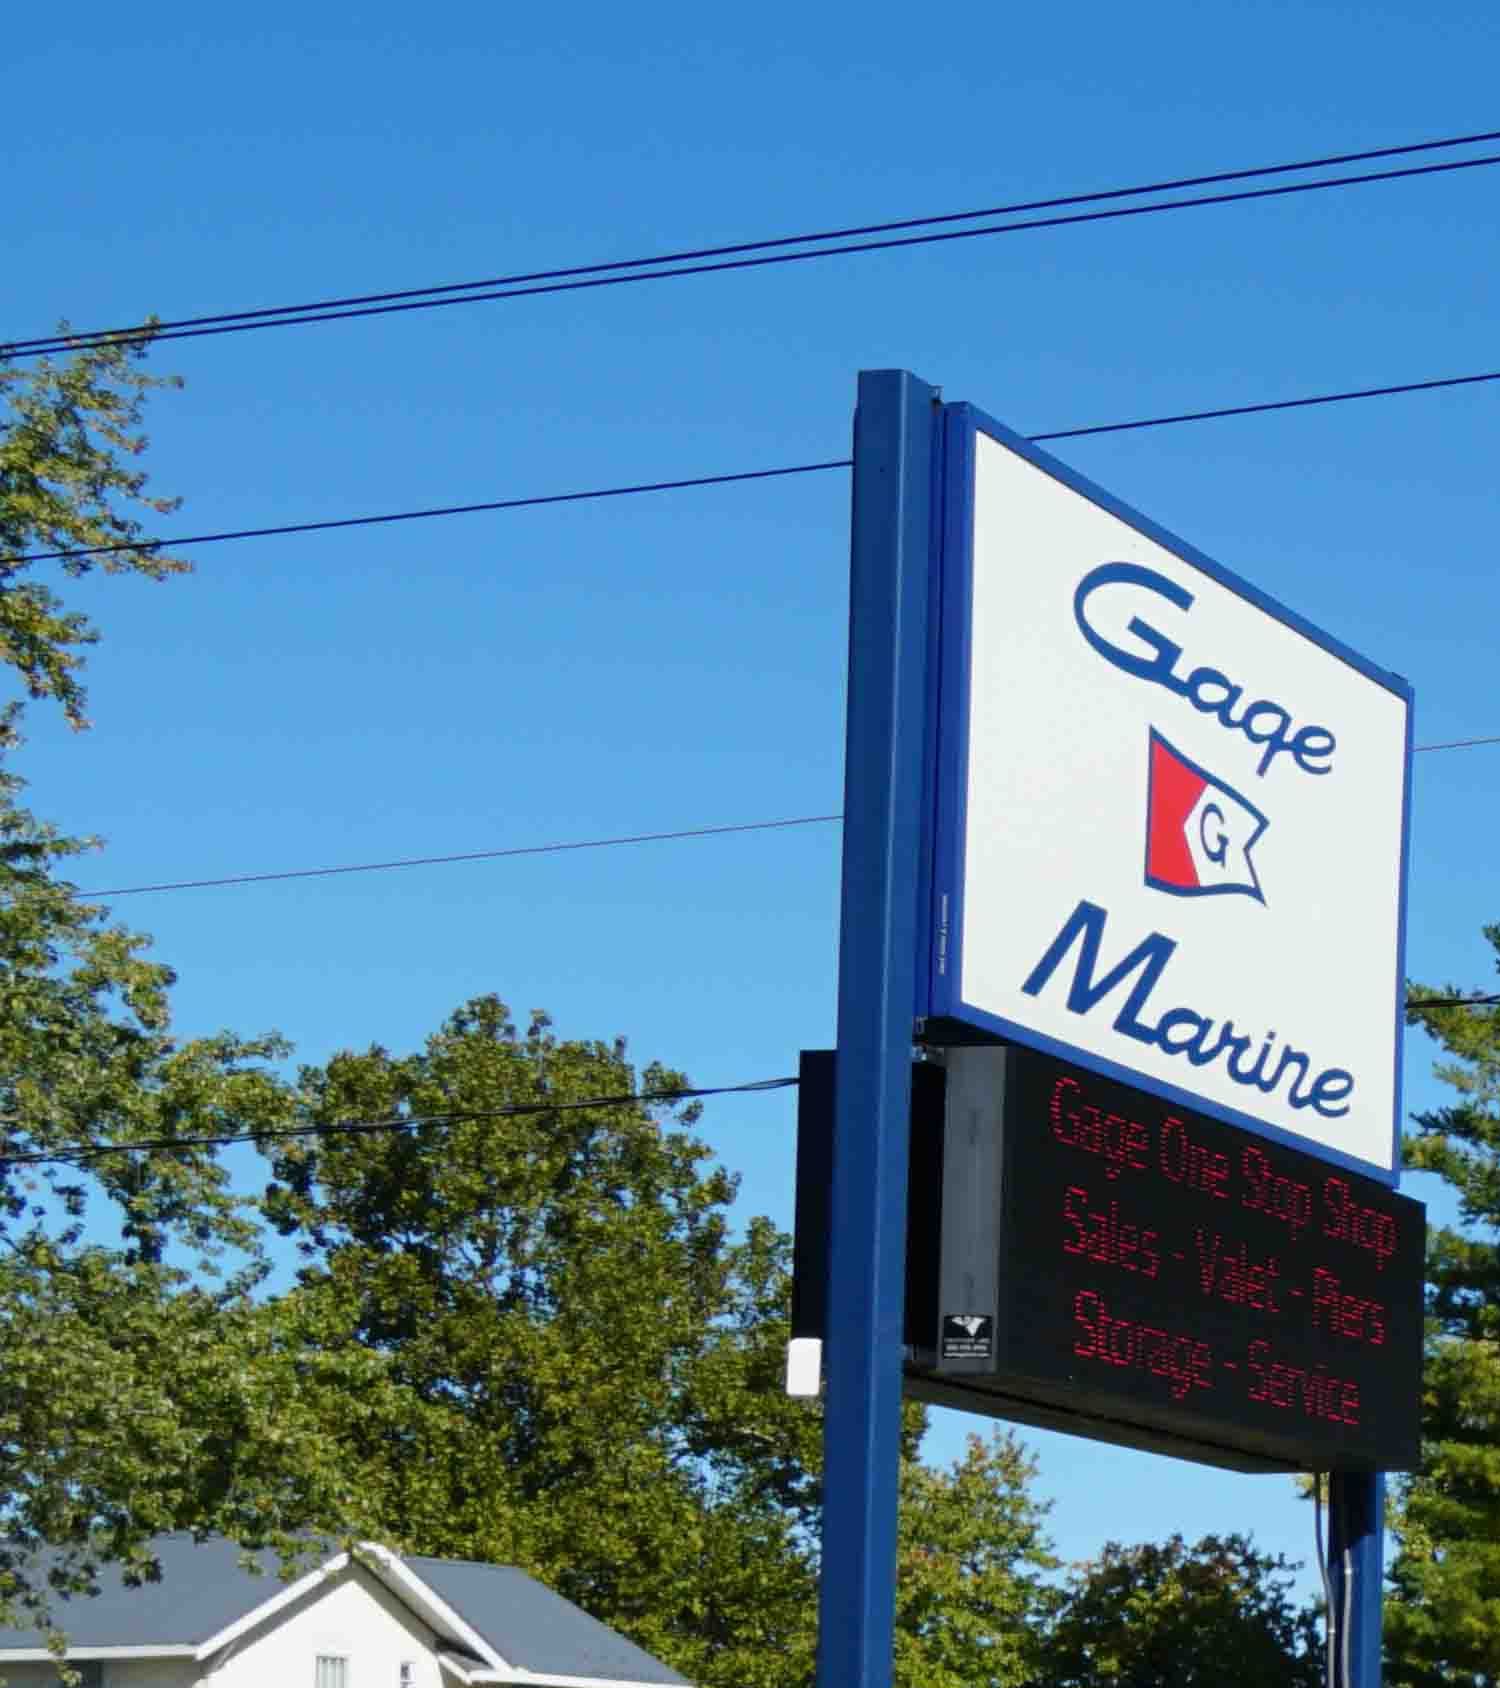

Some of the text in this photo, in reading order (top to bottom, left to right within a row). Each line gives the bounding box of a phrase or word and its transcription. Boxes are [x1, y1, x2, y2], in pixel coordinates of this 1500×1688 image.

[1073, 561, 1336, 777] Gage
[1200, 803, 1229, 866] G
[1020, 900, 1355, 1118] Marine
[1049, 1076, 1399, 1271] Gage One Stop Shop
[1063, 1185, 1160, 1280] Sales
[1193, 1225, 1281, 1314] Valet
[1312, 1265, 1386, 1345] Piers
[1072, 1289, 1213, 1400] Storage
[1247, 1338, 1361, 1426] Service
